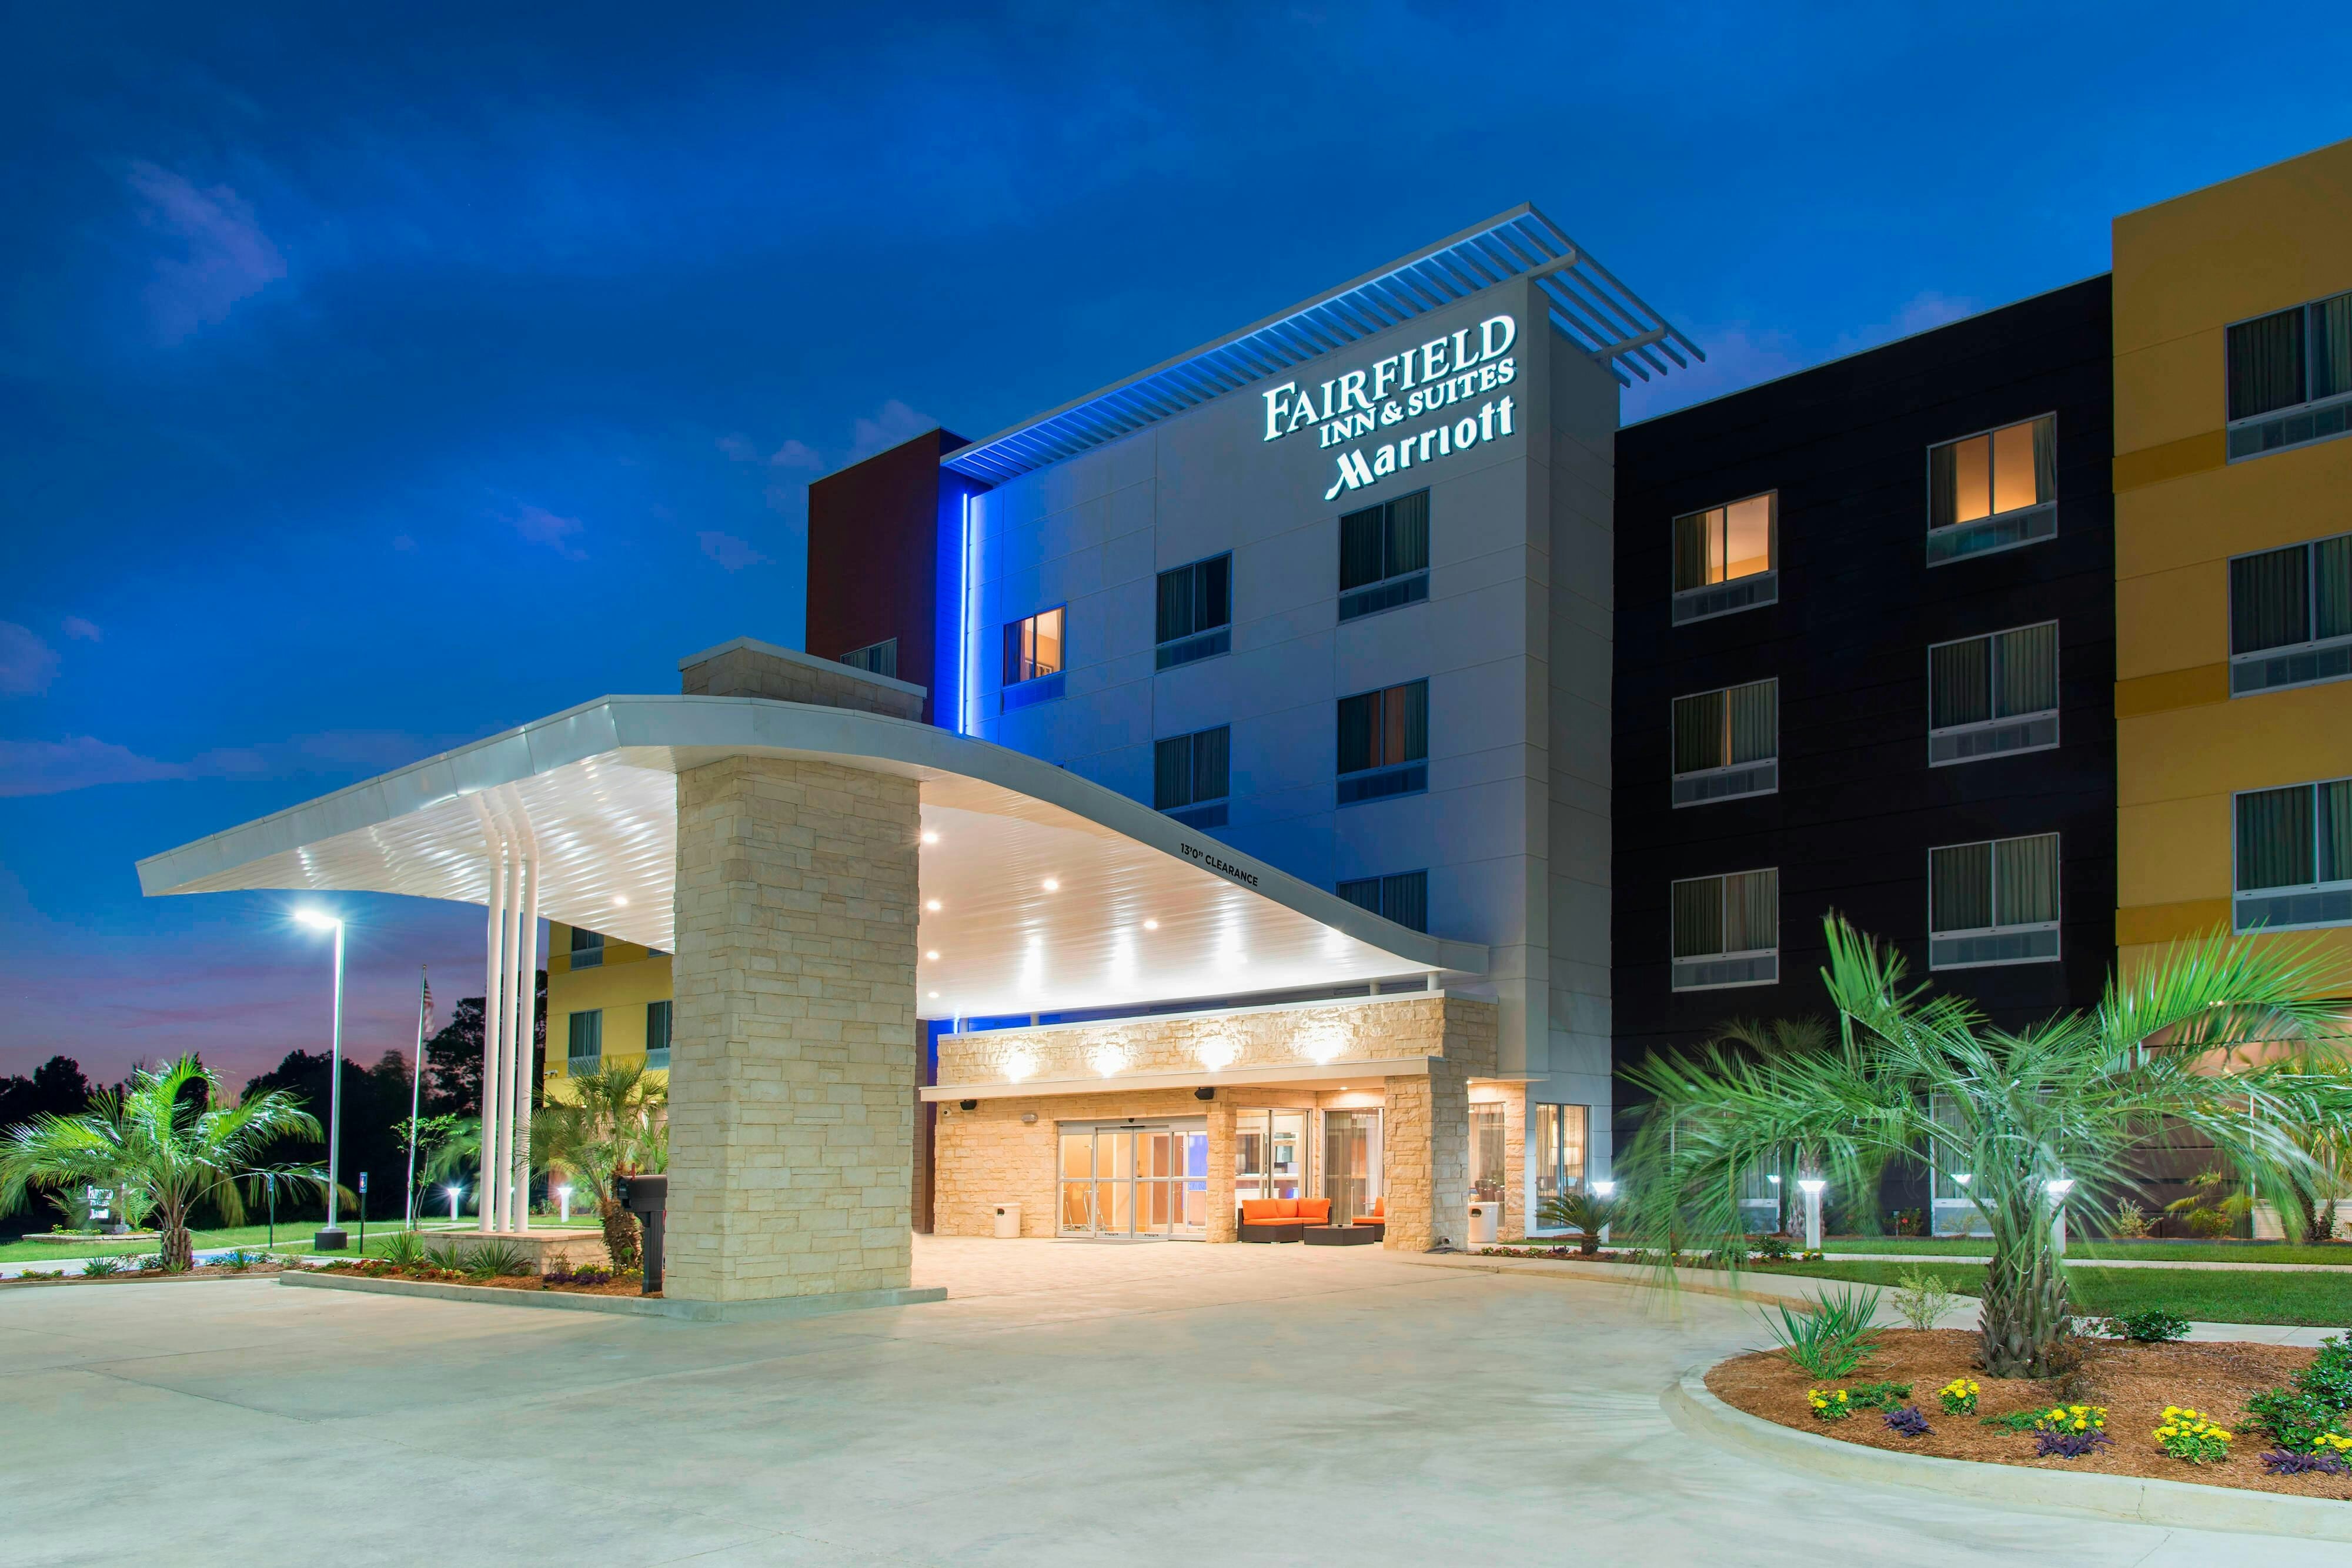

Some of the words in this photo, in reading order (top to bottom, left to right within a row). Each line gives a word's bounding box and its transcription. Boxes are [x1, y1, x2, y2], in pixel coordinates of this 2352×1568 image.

[1262, 315, 1516, 442] FAIRFIELD
[1319, 407, 1377, 448] INN
[1381, 400, 1404, 426] &
[1408, 357, 1515, 416] SUITES
[1324, 395, 1514, 500] Marriott
[1205, 855, 1258, 887] CLEARANCE
